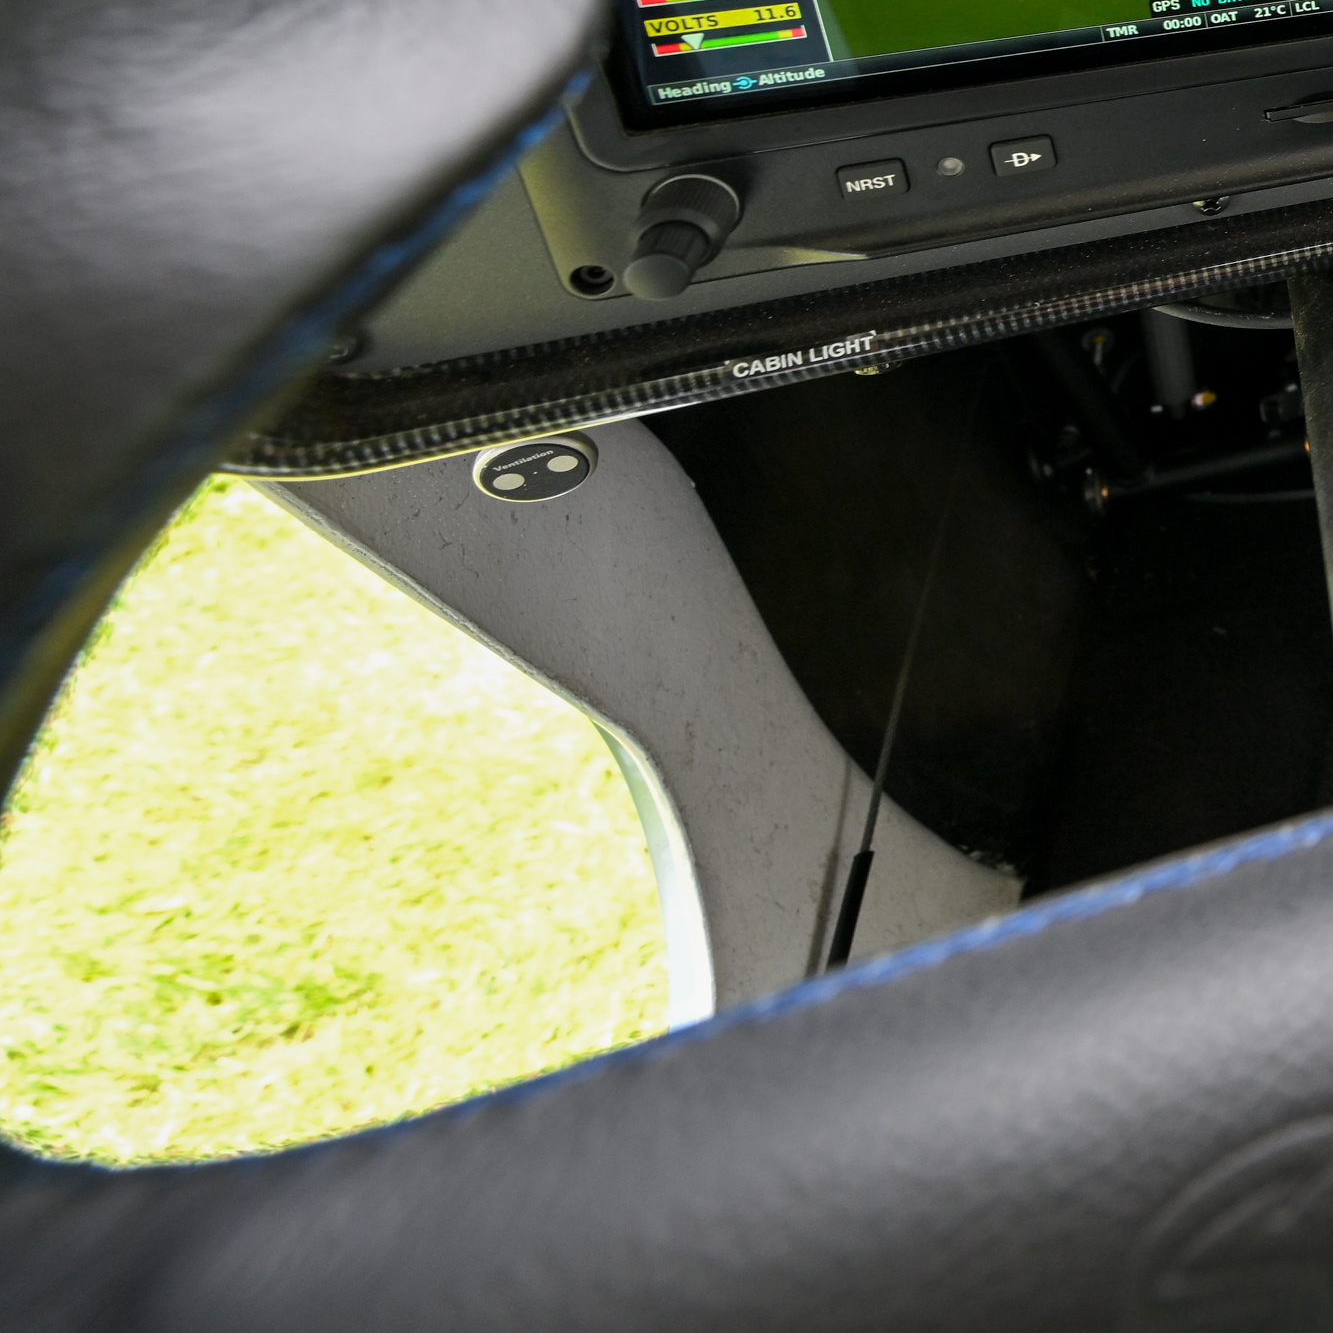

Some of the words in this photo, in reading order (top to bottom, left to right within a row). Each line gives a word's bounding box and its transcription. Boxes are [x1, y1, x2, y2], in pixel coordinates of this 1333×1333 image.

[1152, 0, 1180, 14] GPS
[1295, 0, 1320, 14] LCL
[649, 15, 719, 34] VOLTS
[754, 6, 796, 22] 11.6
[1106, 24, 1139, 39] TMR
[1163, 16, 1202, 32] 00:00
[1210, 11, 1238, 25] OAT
[758, 67, 826, 87] Altitude
[657, 80, 733, 100] Heading
[845, 173, 896, 194] NRST
[732, 346, 804, 380] CABIN
[809, 334, 875, 364] LIGHT
[493, 449, 554, 473] Ventilation
